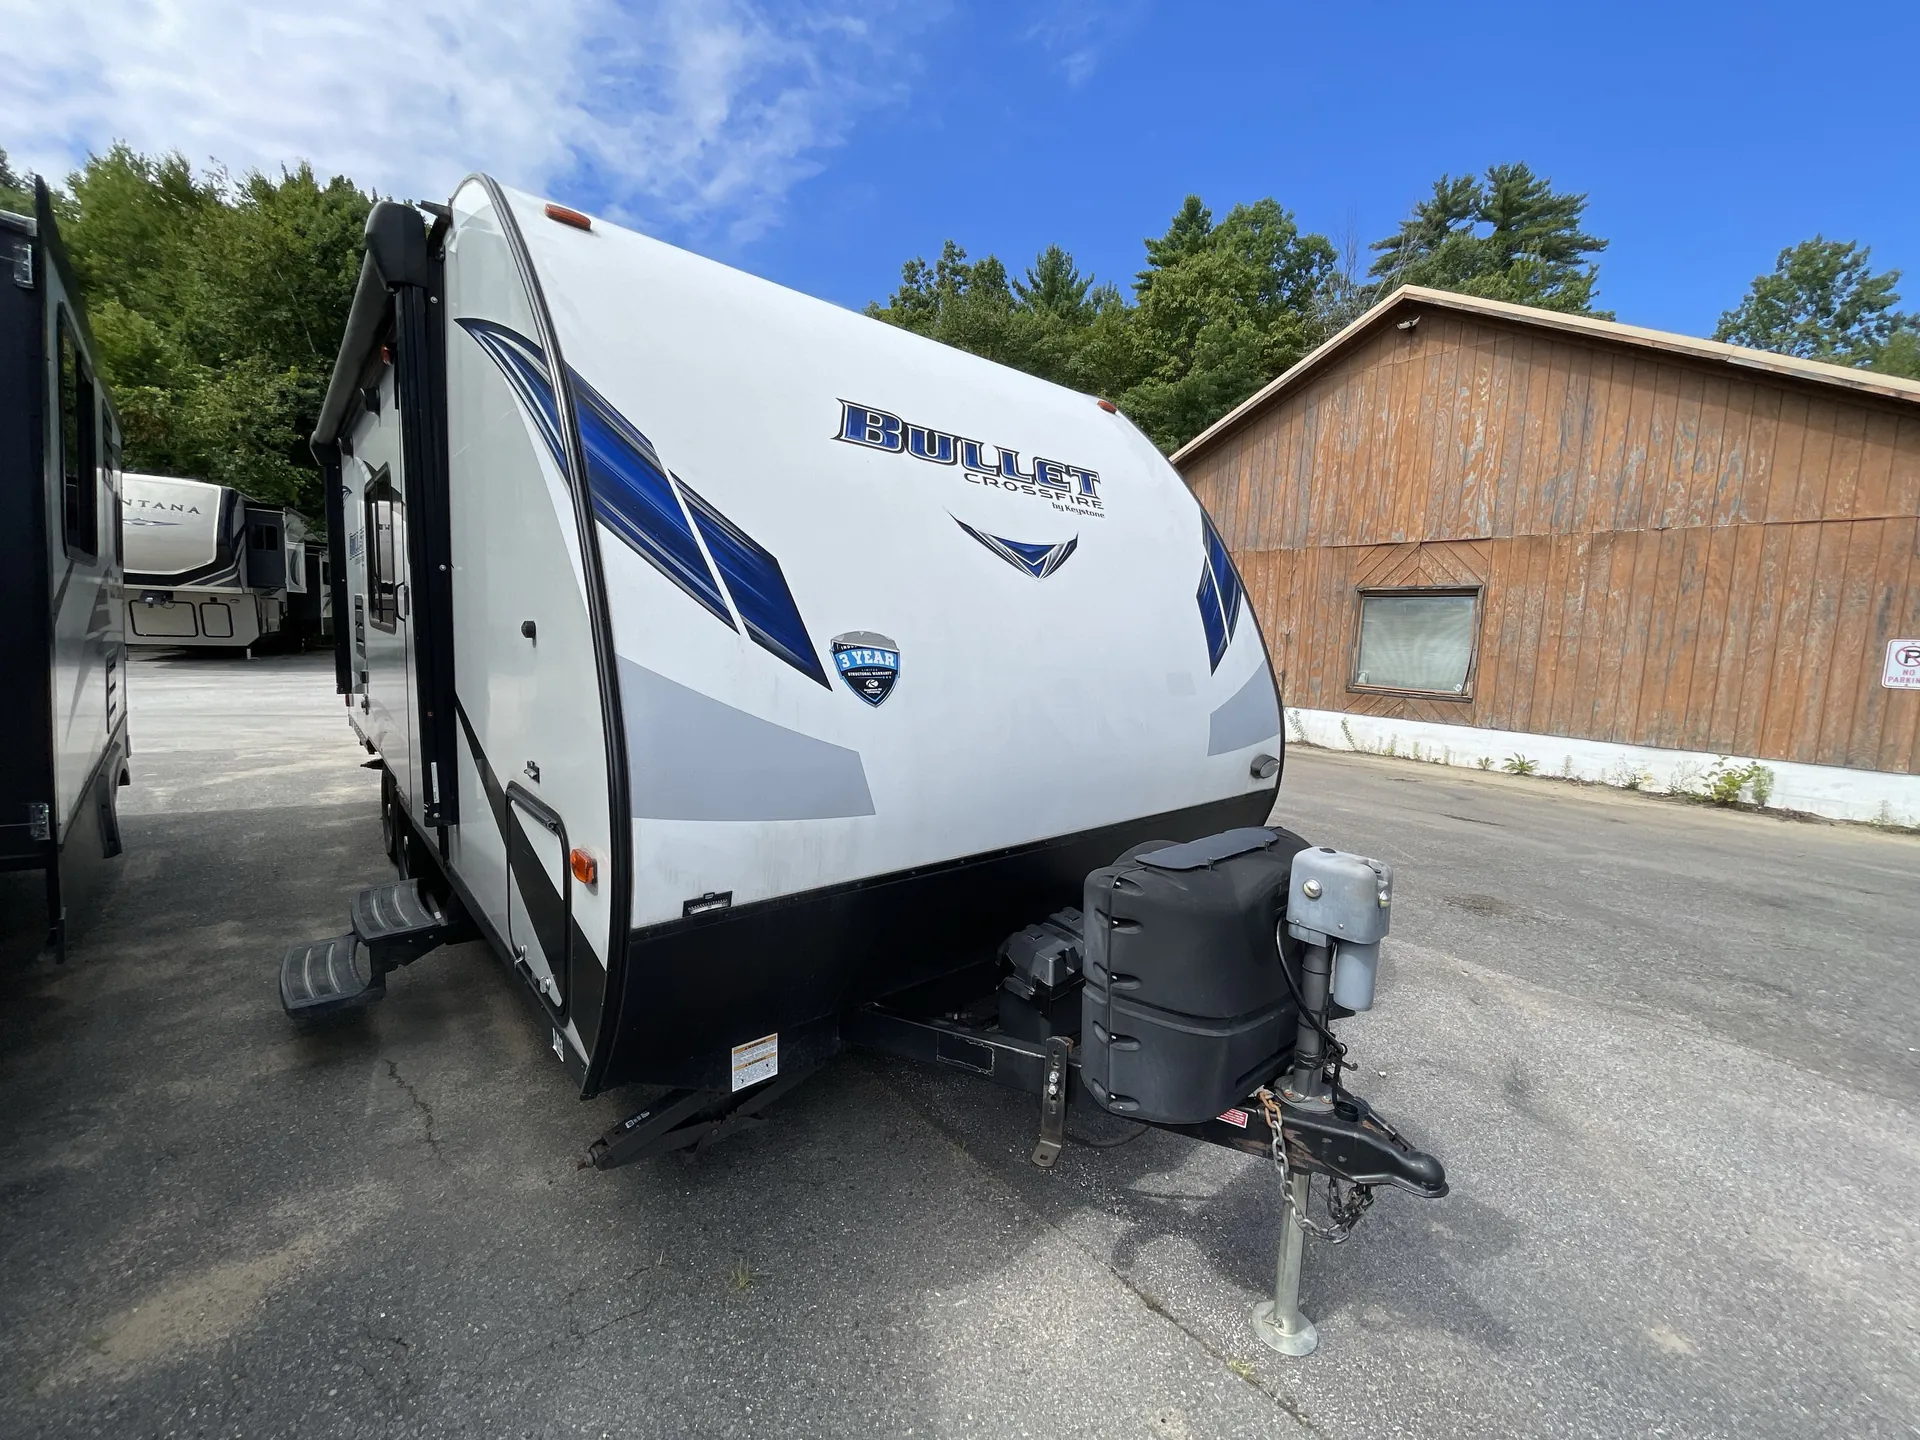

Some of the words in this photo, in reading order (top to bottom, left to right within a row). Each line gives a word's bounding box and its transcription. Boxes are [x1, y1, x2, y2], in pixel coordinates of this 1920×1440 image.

[830, 397, 1101, 500] BULLET
[964, 472, 1104, 510] CROSSFIRE
[121, 498, 201, 515] NTANA
[1051, 501, 1065, 512] by
[1065, 504, 1105, 519] Keystone
[838, 653, 851, 668] 3
[851, 650, 895, 667] YEAR
